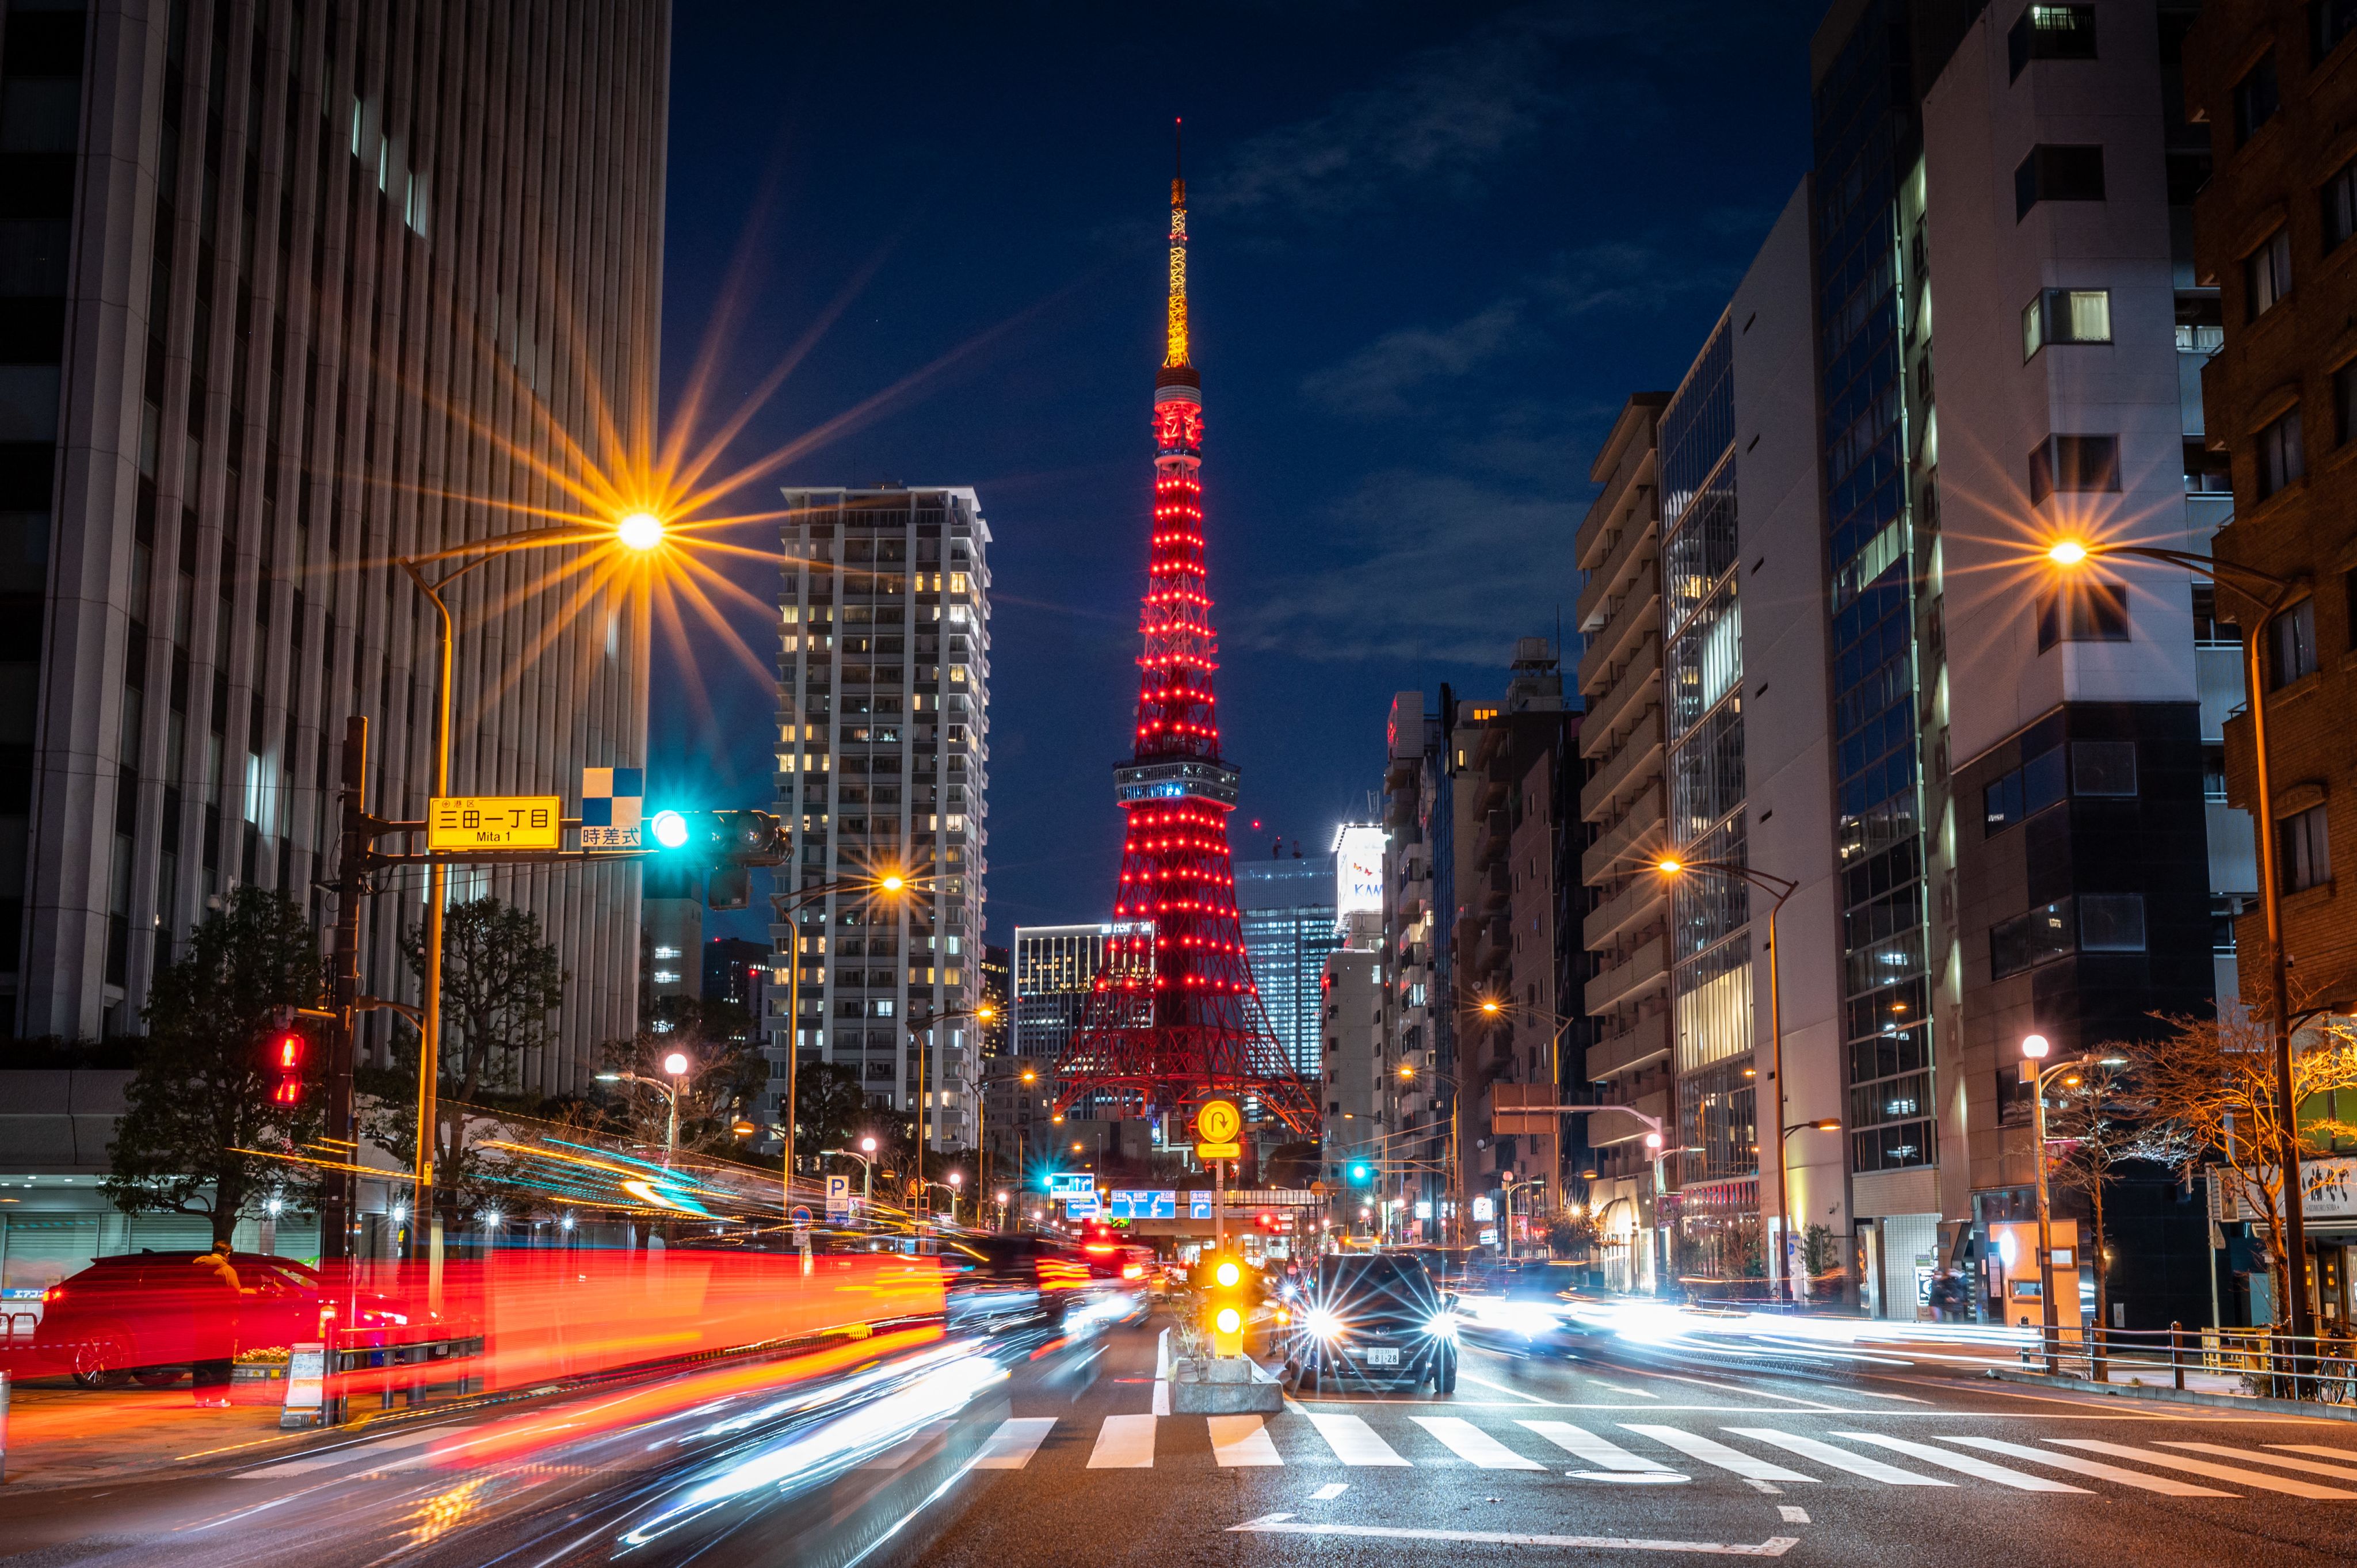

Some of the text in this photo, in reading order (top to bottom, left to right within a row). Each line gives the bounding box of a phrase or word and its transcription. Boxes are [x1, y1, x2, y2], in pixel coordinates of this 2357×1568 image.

[439, 809, 548, 829] 三田一丁目
[476, 831, 510, 842] Mita 1
[582, 827, 640, 845] 時差式
[831, 1178, 845, 1196] P
